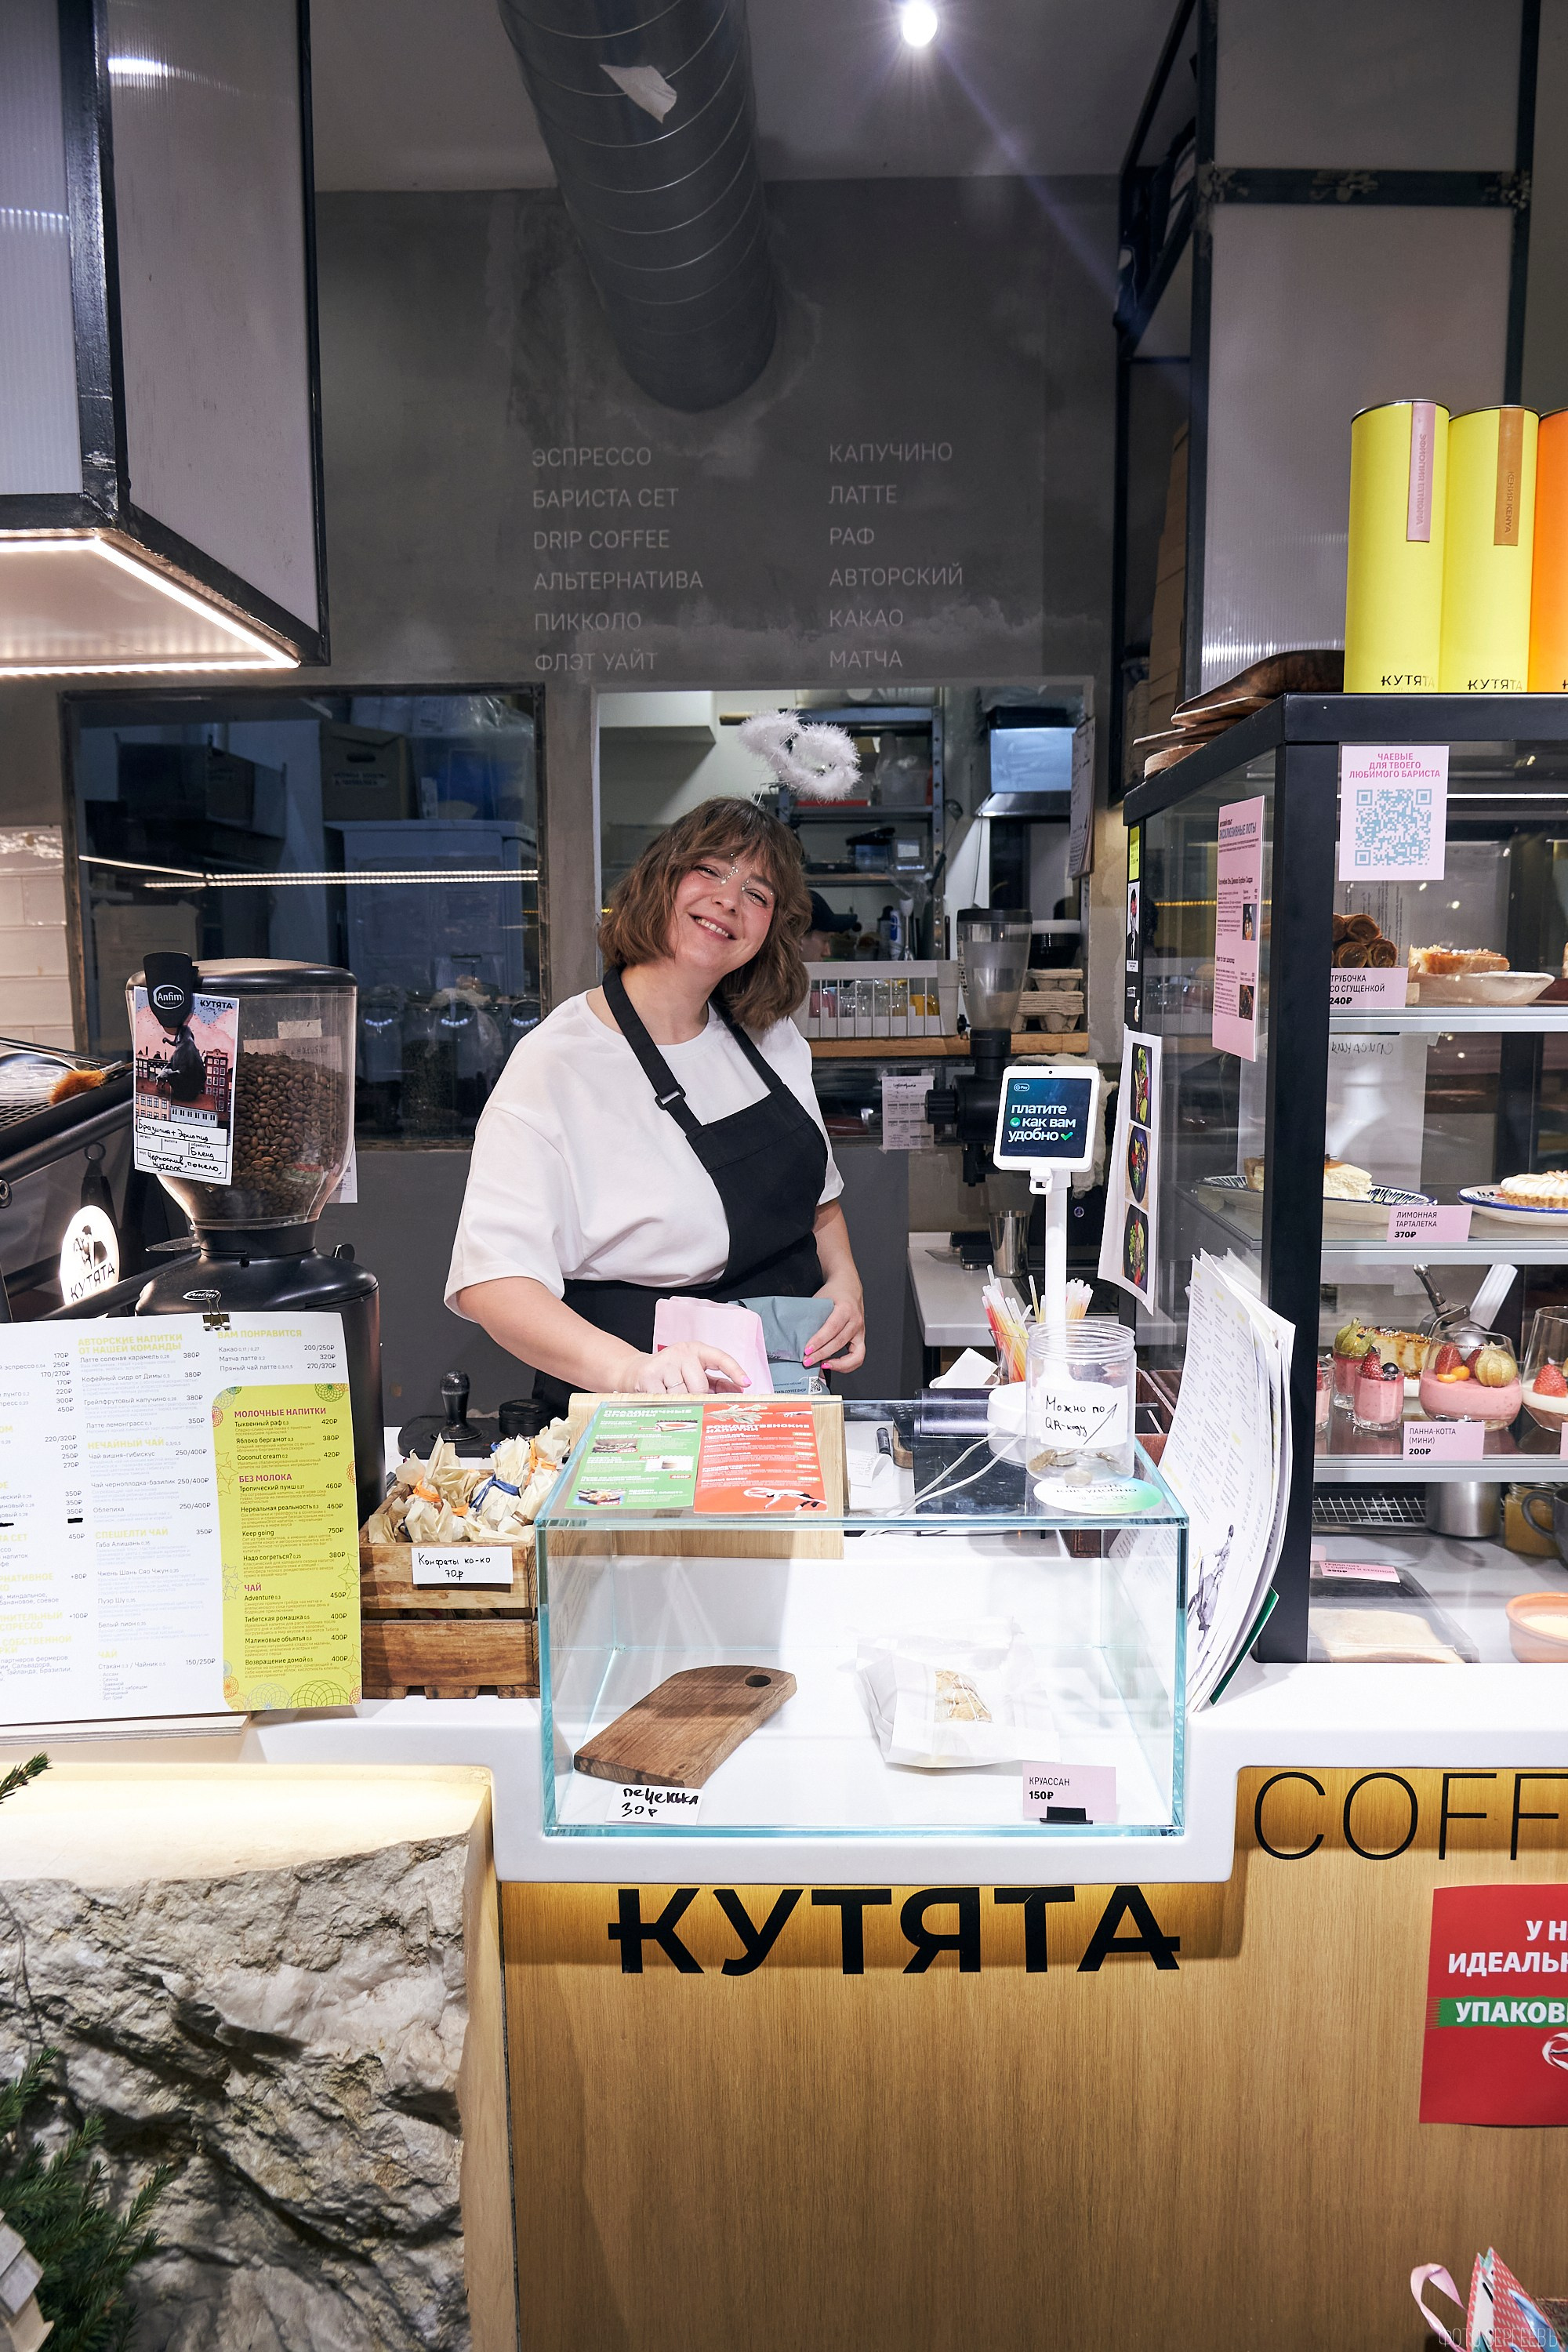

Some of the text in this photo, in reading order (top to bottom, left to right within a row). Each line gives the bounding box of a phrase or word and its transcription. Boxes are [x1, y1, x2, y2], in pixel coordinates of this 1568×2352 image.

[532, 448, 652, 467] ЭСПРЕССО
[829, 442, 953, 463] КАПУЧИНО
[829, 485, 898, 505] ЛАТТЕ
[1506, 471, 1515, 501] КЕНИЯ
[533, 488, 679, 509] БАРИСТА СЕТ
[534, 529, 670, 550] DRIP COFFEE
[829, 527, 875, 546] РАФ
[534, 570, 703, 591] АЛЬТЕРНАТИВА
[829, 562, 964, 587] АВТОРСКИЙ
[535, 612, 642, 631] ПИККОЛО
[829, 609, 904, 628] КАКАО
[535, 648, 658, 672] ФЛЭТ УАЙТ
[829, 650, 903, 669] МАТЧА
[1381, 675, 1435, 687] КУТЯТА
[1468, 679, 1523, 690] КУТЯТА
[1369, 762, 1387, 771] ДЛЯ
[158, 992, 182, 1001] Anfim
[1341, 983, 1385, 993] СГУЩЕНКОЙ
[200, 1000, 233, 1009] КУТЯТА
[1011, 1104, 1067, 1115] платите
[1022, 1117, 1076, 1128] как вам
[1008, 1127, 1059, 1143] удобно
[71, 1262, 115, 1302] КУТЯТА
[78, 1334, 183, 1346] АВТОРСКИЕ НАПИТКИ
[241, 1330, 302, 1338] ПОНРАВИТСЯ
[93, 1345, 129, 1353] НАШЕЙ
[130, 1343, 181, 1352] КОМАНДЫ
[234, 1407, 326, 1418] МОЛОЧНЫЕ НАПИТКИ
[1045, 1395, 1086, 1413] Можно
[88, 1438, 164, 1449] НЕЧАЙНЫЙ ЧАЙ
[244, 1582, 262, 1592] ЧАЙ
[1029, 1777, 1070, 1786] КРУАССАН
[1029, 1791, 1054, 1799] 150₽
[1254, 1772, 1568, 1860] COFF
[608, 1885, 1181, 1976] КУТЯТА
[1526, 1920, 1568, 1941] У Н
[1456, 2002, 1568, 2024] УПАКОВ
